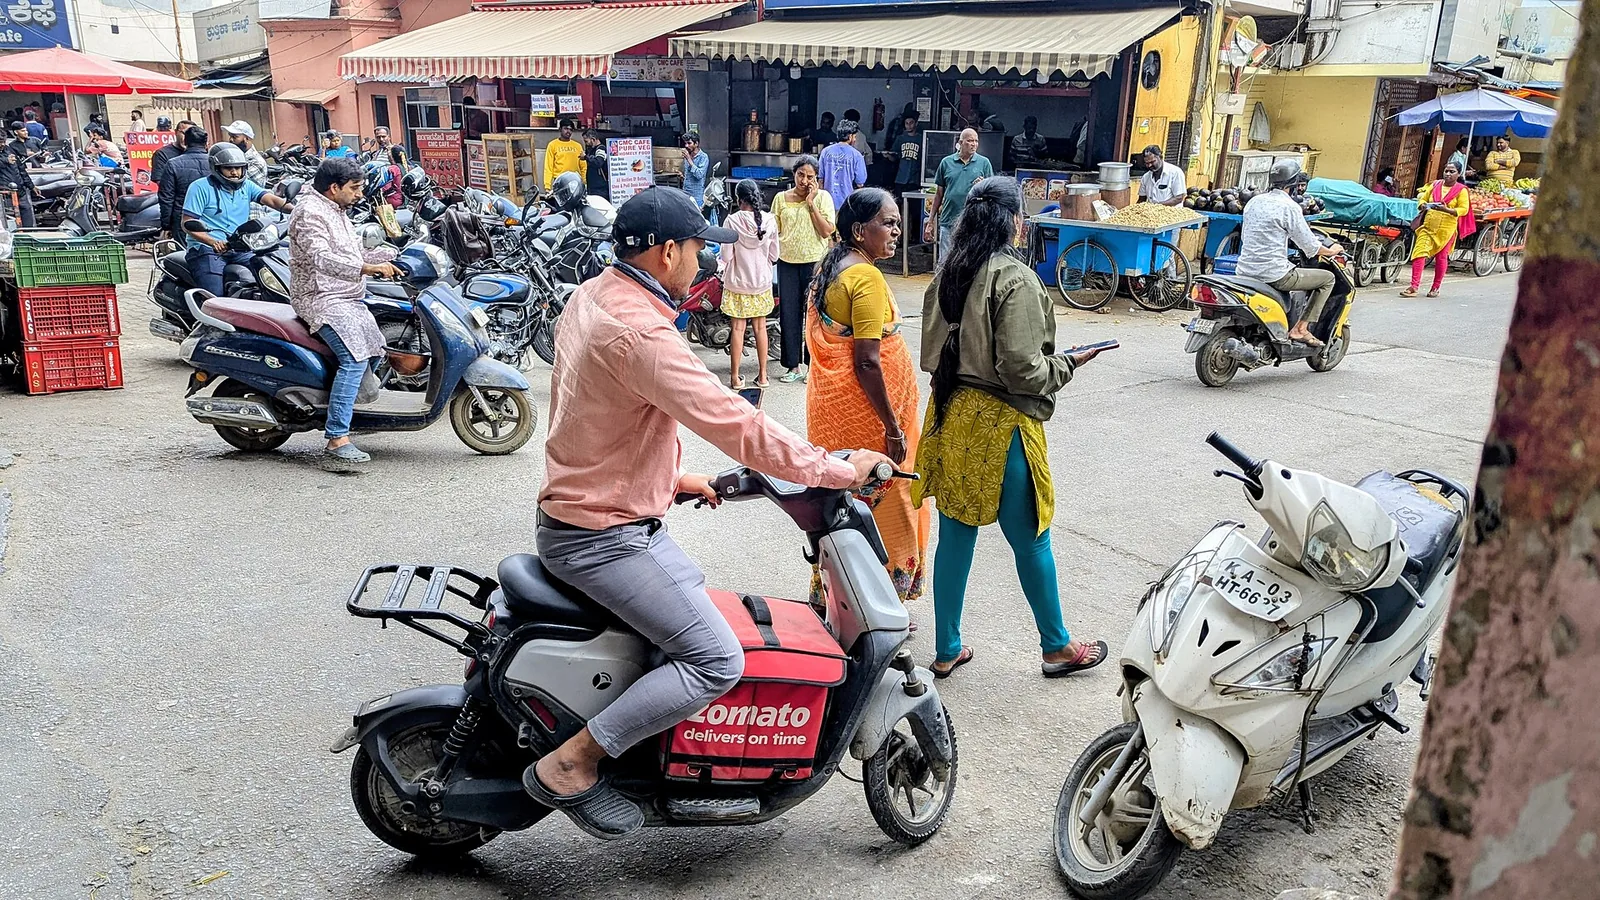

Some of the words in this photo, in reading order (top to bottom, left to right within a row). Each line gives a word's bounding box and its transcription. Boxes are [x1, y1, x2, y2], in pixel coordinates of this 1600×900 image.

[138, 134, 159, 145] CMC
[161, 134, 177, 144] CA
[901, 142, 920, 152] GOOD
[131, 150, 155, 159] BANG
[901, 150, 918, 160] VIBE
[25, 299, 34, 335] SAS
[683, 727, 746, 745] delivers
[748, 733, 768, 745] on
[772, 731, 807, 746] time
